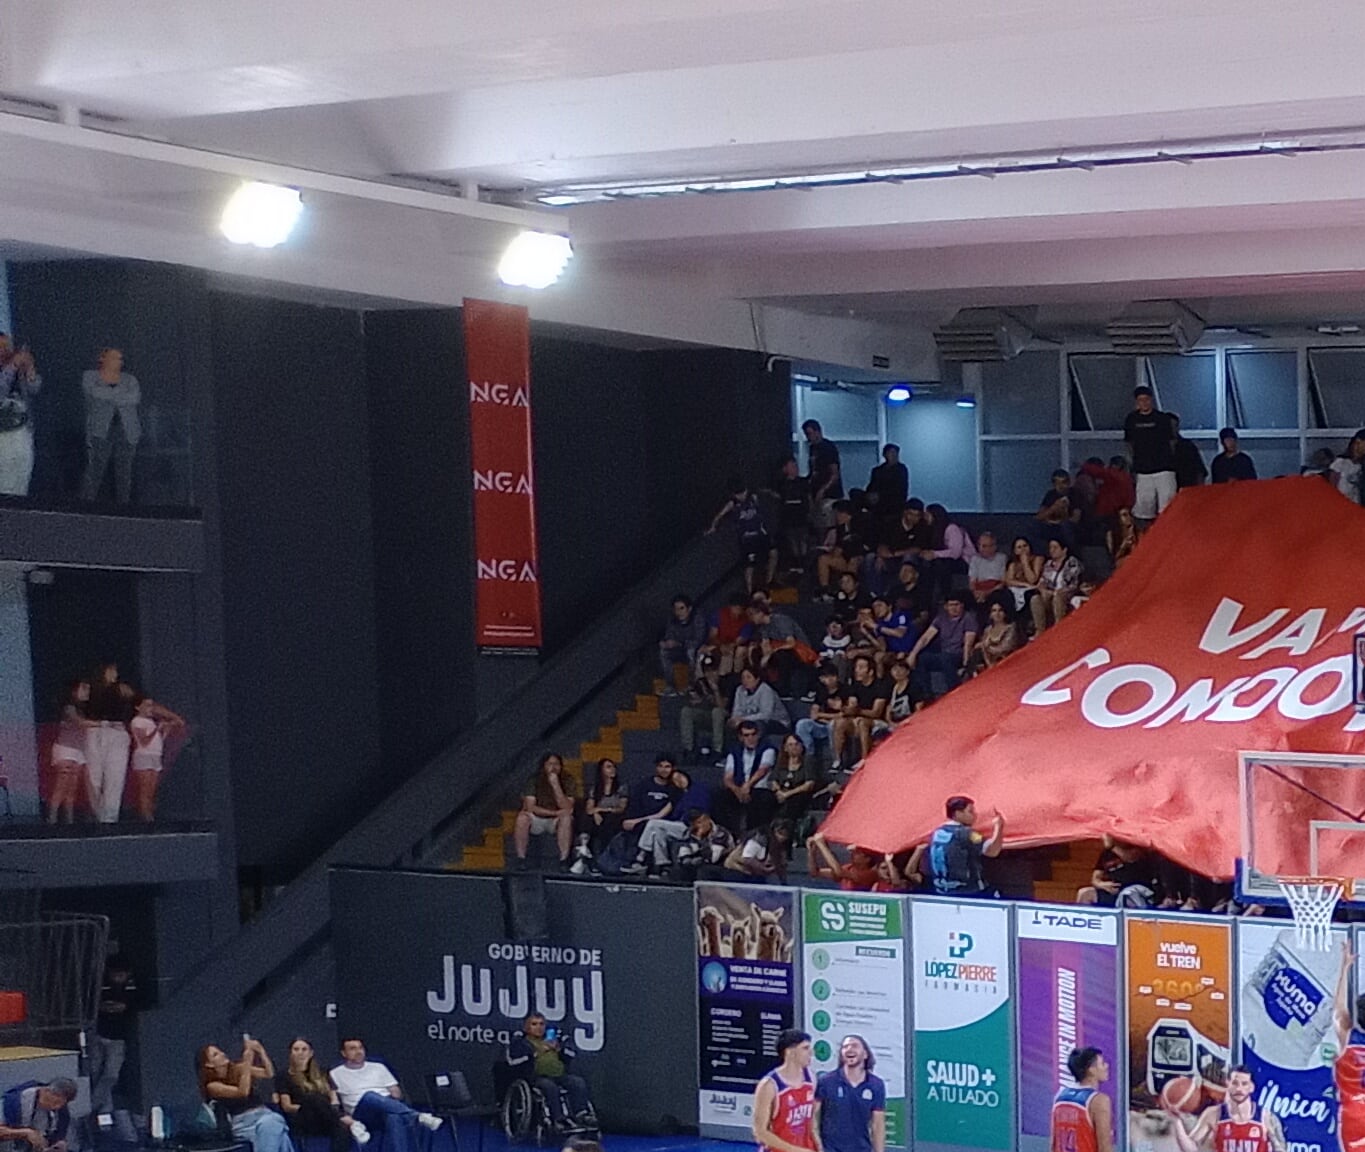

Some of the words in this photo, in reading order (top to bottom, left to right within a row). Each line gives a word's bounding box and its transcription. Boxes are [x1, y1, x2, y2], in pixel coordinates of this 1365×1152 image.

[1044, 915, 1102, 930] TADE
[488, 944, 575, 965] GOBIERNO
[579, 949, 602, 966] DE
[1157, 954, 1172, 967] EL
[1173, 955, 1200, 969] TREN
[1057, 967, 1076, 1020] MOTION
[428, 1020, 445, 1040] el
[448, 1024, 494, 1043] norte
[927, 1060, 979, 1087] SALUD
[927, 1088, 940, 1101] A
[959, 1090, 999, 1108] LADO
